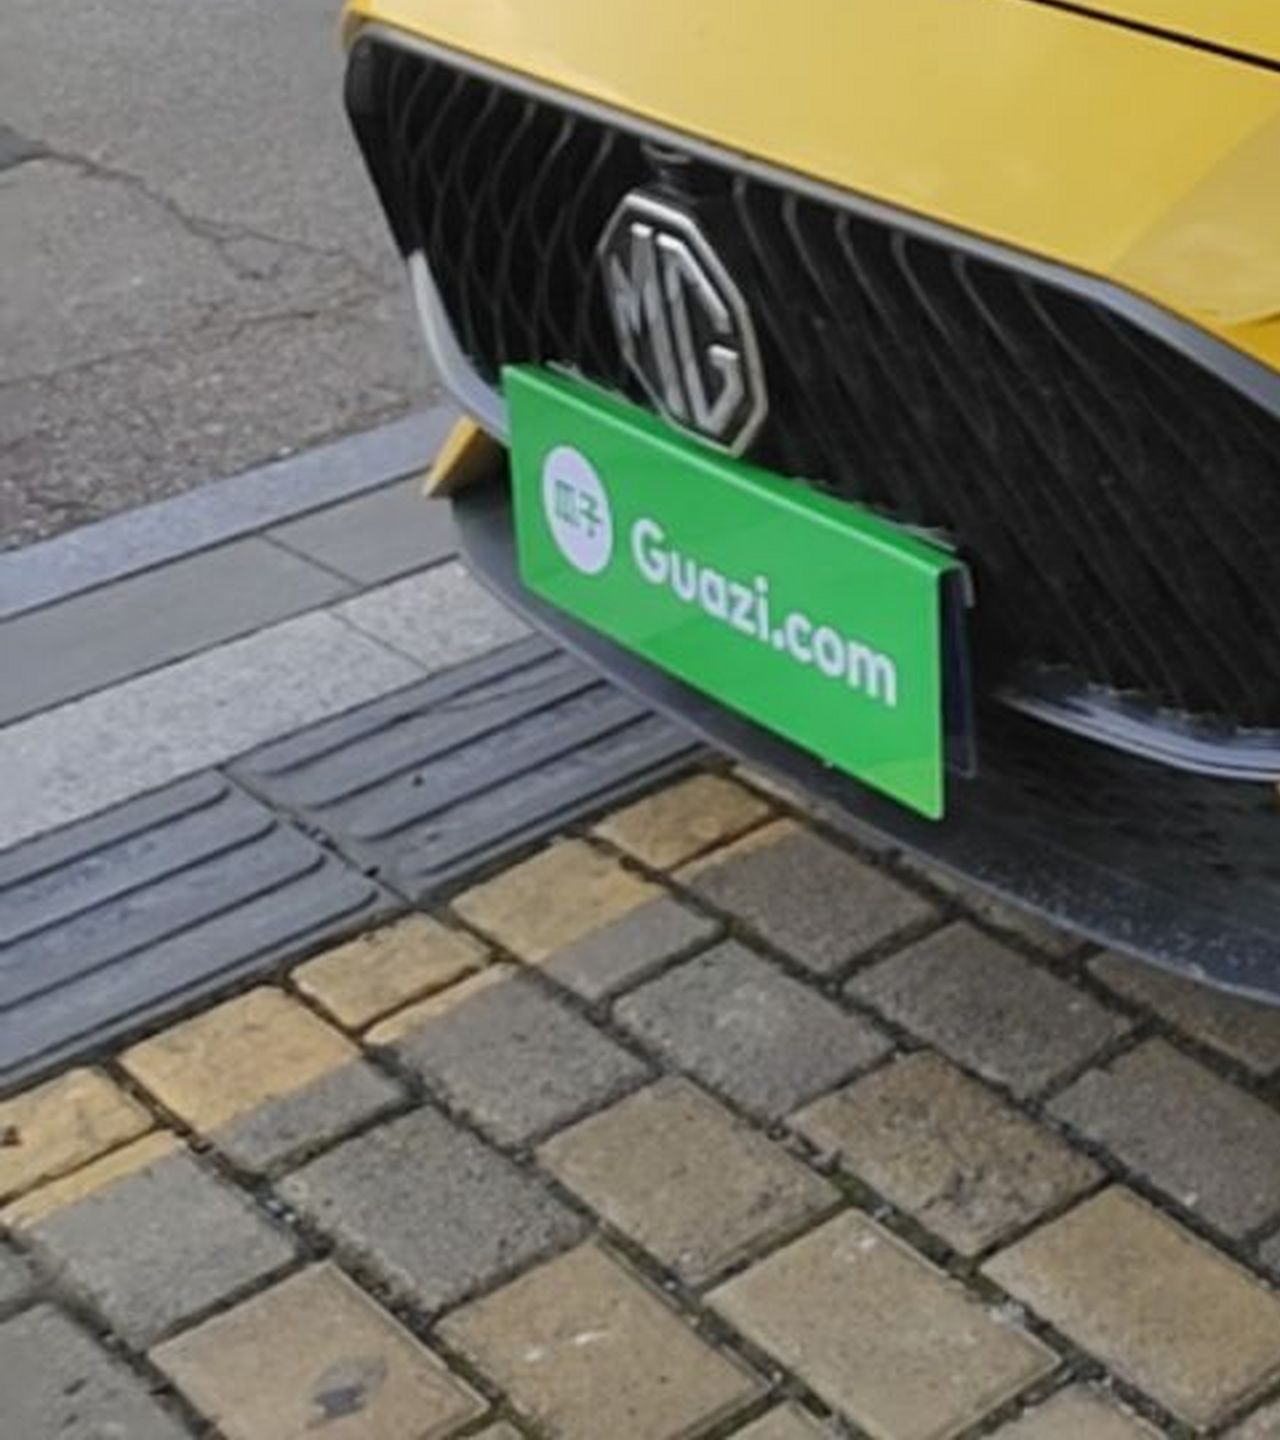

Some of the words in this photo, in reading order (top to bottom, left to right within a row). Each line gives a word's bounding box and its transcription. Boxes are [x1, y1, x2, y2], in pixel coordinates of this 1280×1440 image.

[601, 220, 746, 436] MG
[553, 477, 602, 540] 瓜子
[631, 517, 897, 707] Guazi.com
